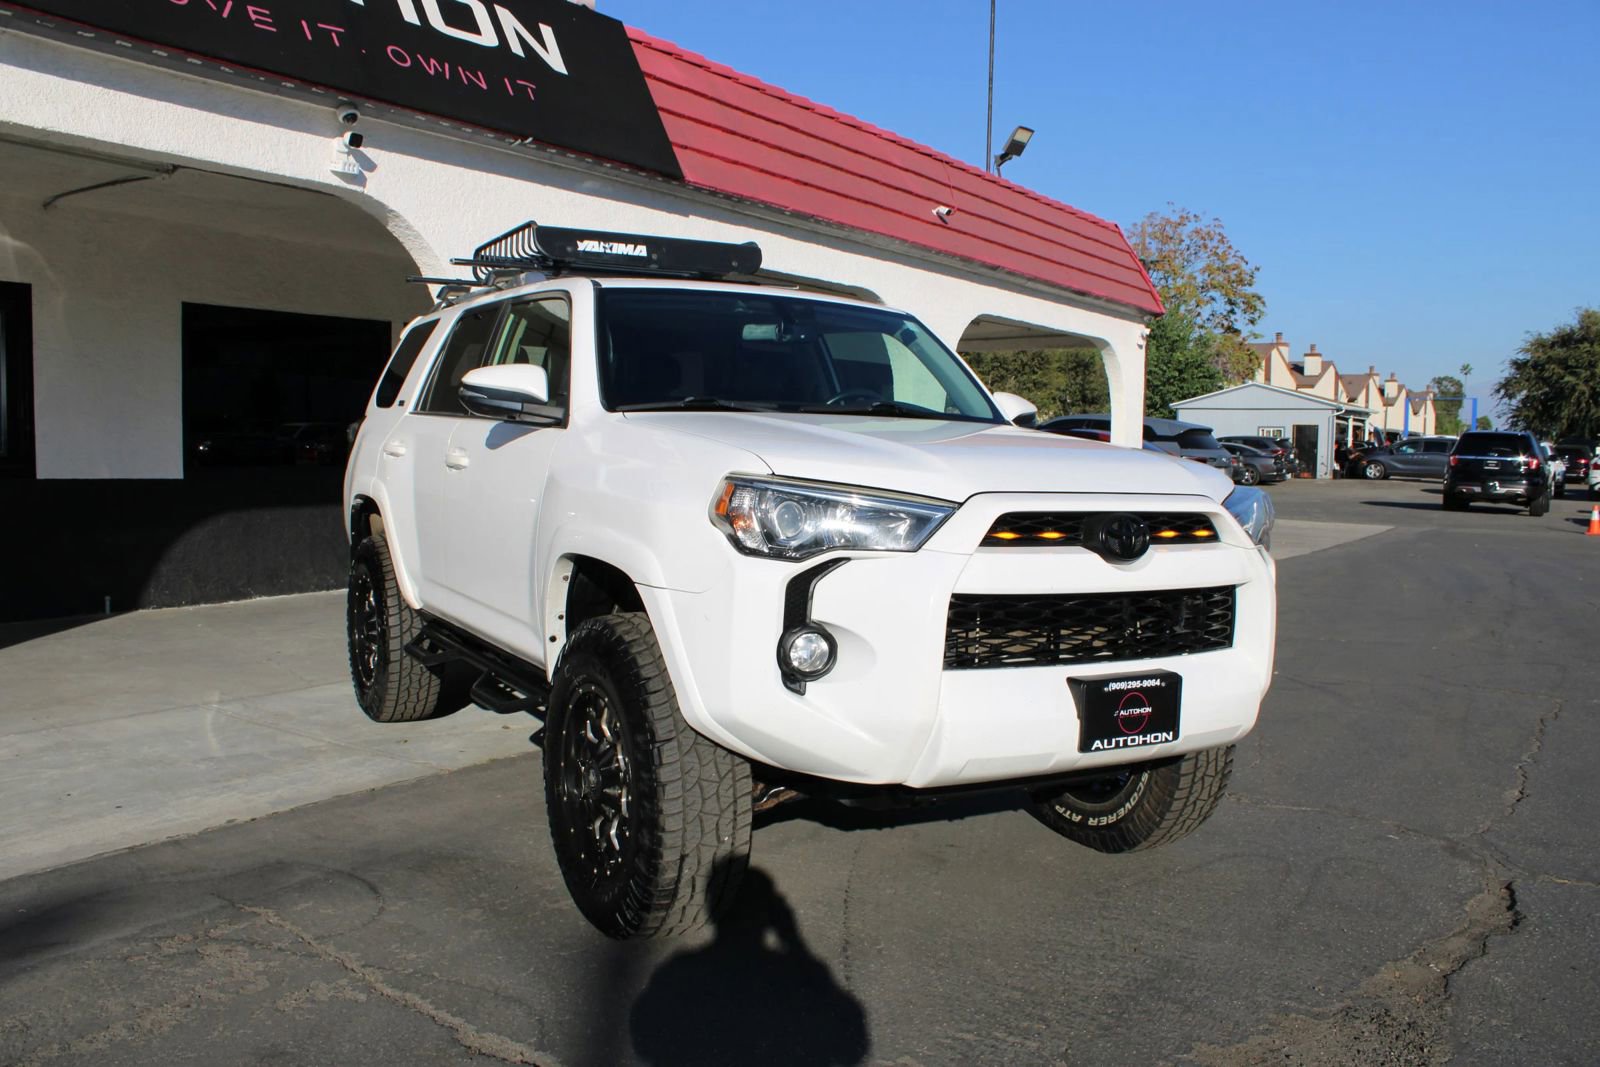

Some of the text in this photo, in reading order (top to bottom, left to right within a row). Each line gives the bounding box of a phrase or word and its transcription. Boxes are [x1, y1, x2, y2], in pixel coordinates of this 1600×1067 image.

[350, 0, 568, 75] ON
[386, 45, 488, 90] OWN
[504, 77, 537, 101] IT
[577, 240, 647, 257] YAKIMA
[1119, 706, 1152, 716] AUTOHON
[1091, 731, 1173, 751] AUTOHON
